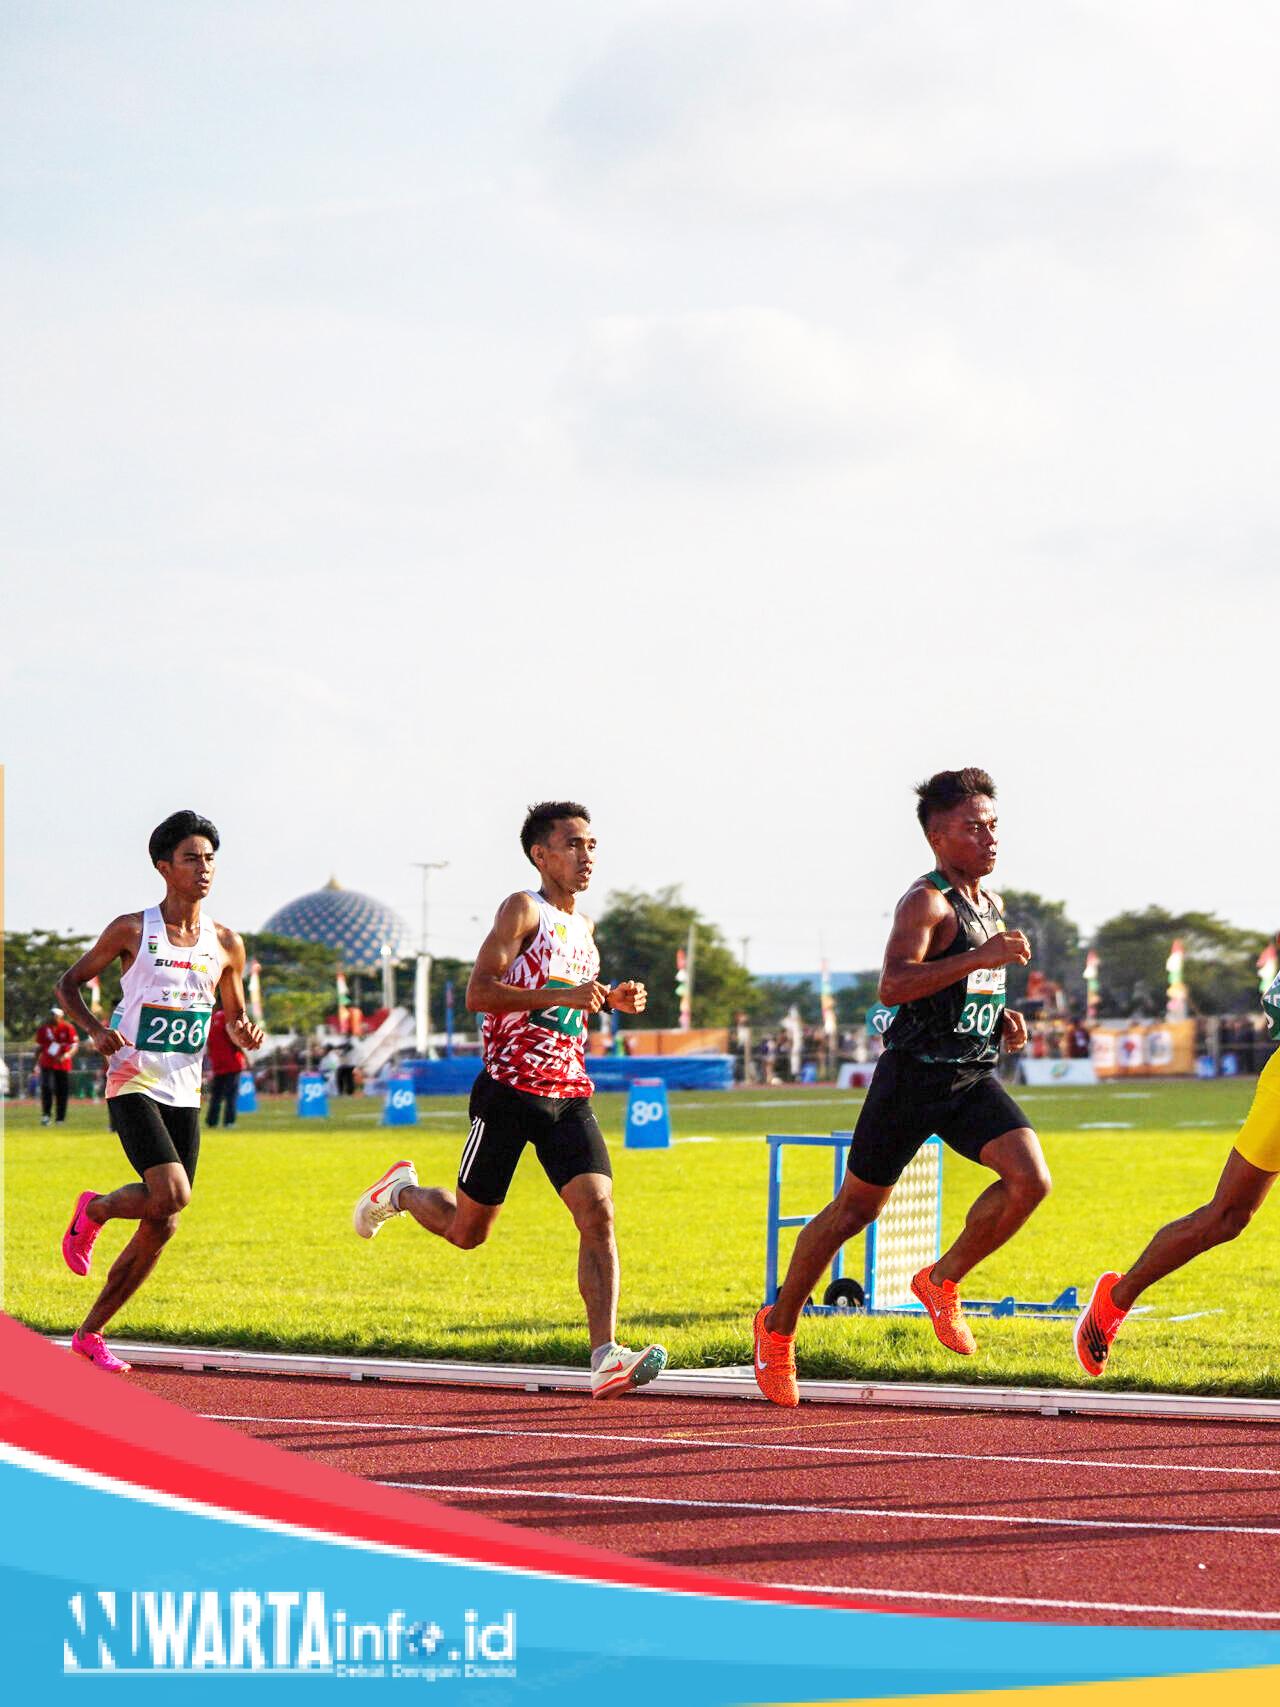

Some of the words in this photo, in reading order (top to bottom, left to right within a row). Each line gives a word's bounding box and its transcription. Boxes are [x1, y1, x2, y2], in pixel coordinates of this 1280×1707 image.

[146, 1016, 204, 1047] 286
[392, 1088, 414, 1109] 60
[631, 1100, 663, 1127] 80
